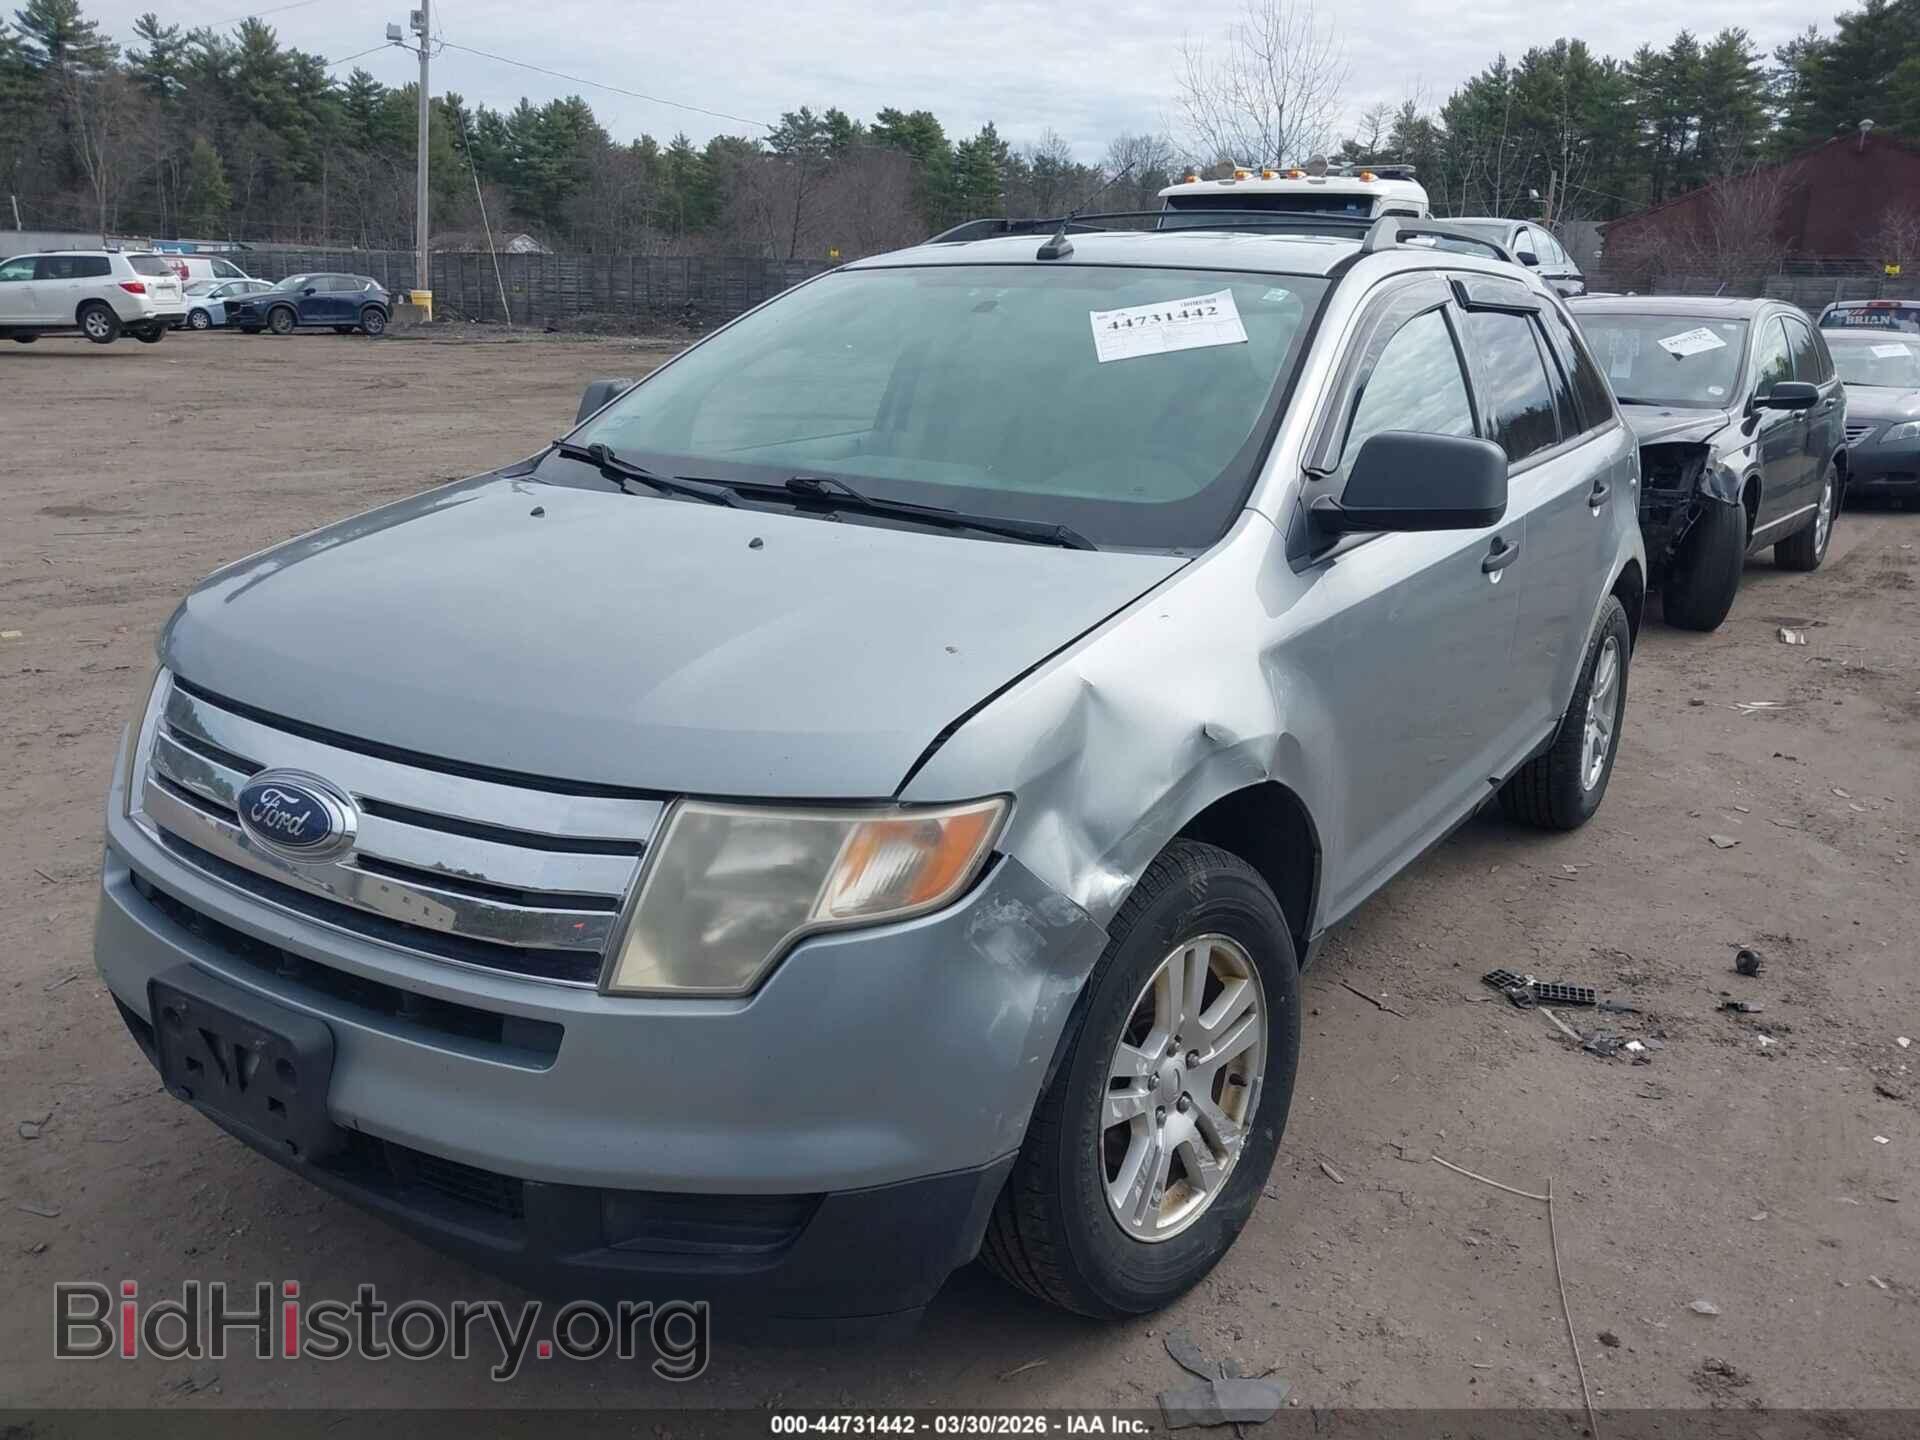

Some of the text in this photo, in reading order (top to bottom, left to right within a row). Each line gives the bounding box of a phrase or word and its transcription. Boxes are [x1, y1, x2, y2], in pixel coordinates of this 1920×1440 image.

[1107, 305, 1219, 330] 44731442
[1846, 315, 1890, 325] BRIAN
[251, 788, 311, 836] Ford
